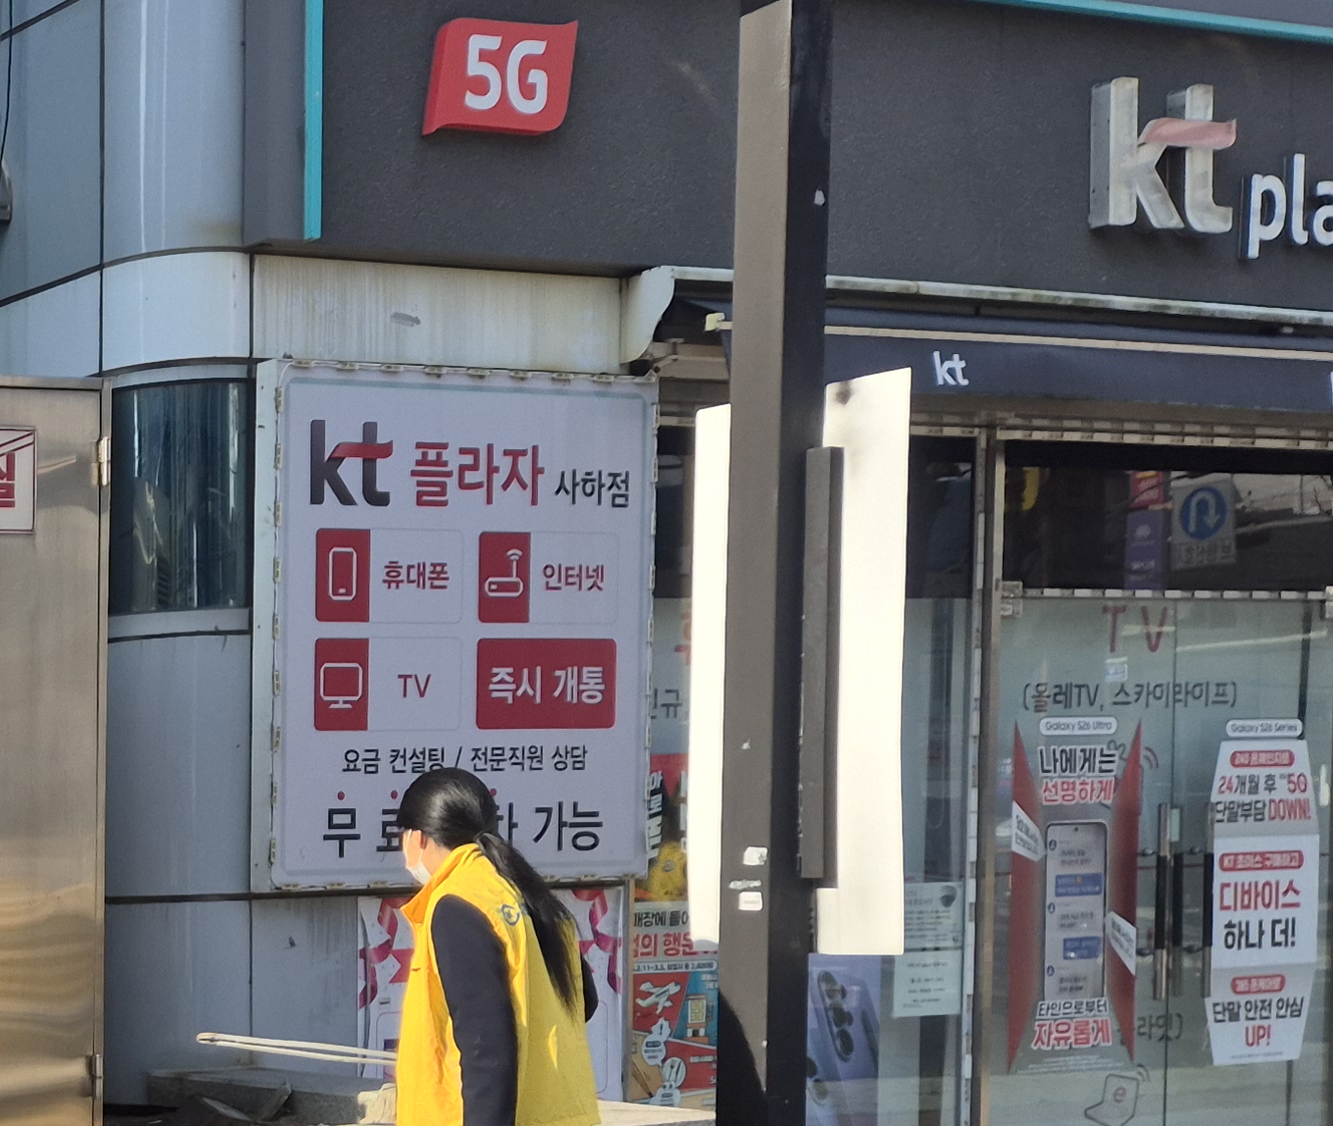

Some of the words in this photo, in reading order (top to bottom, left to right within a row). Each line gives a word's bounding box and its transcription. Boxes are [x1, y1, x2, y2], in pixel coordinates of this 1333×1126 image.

[464, 33, 548, 115] 5G
[1090, 76, 1237, 233] kt
[933, 350, 970, 387] kt
[309, 419, 393, 507] kt
[409, 441, 545, 507] 플라자
[554, 469, 630, 508] 사하점
[381, 560, 451, 592] 휴대폰
[541, 563, 606, 593] 인터넷
[397, 673, 433, 699] TV
[488, 665, 543, 705] 즉시
[552, 665, 606, 705] 개통
[1045, 720, 1075, 732] Galaxy
[341, 748, 381, 775] 요금
[388, 746, 446, 774] 컨설팅
[470, 744, 545, 772] 전문직원
[551, 744, 588, 771] 상담
[1038, 747, 1117, 775] 나에게는
[1042, 778, 1114, 803] 선명하게
[1218, 773, 1260, 796] 24개월
[1263, 773, 1278, 795] 후
[1214, 799, 1267, 823] 단말부담
[1268, 798, 1312, 822] DOWN!
[533, 800, 604, 852] 가능
[1219, 879, 1302, 912] 디바이스
[1223, 919, 1266, 951] 하나
[1270, 916, 1296, 948] 더!
[1037, 999, 1109, 1018] 타인으로부터
[1212, 1000, 1242, 1023] 단말
[1244, 998, 1273, 1021] 안전
[1275, 996, 1305, 1019] 안심
[1032, 1018, 1112, 1048] 자유롭게
[1245, 1024, 1272, 1047] UP!
